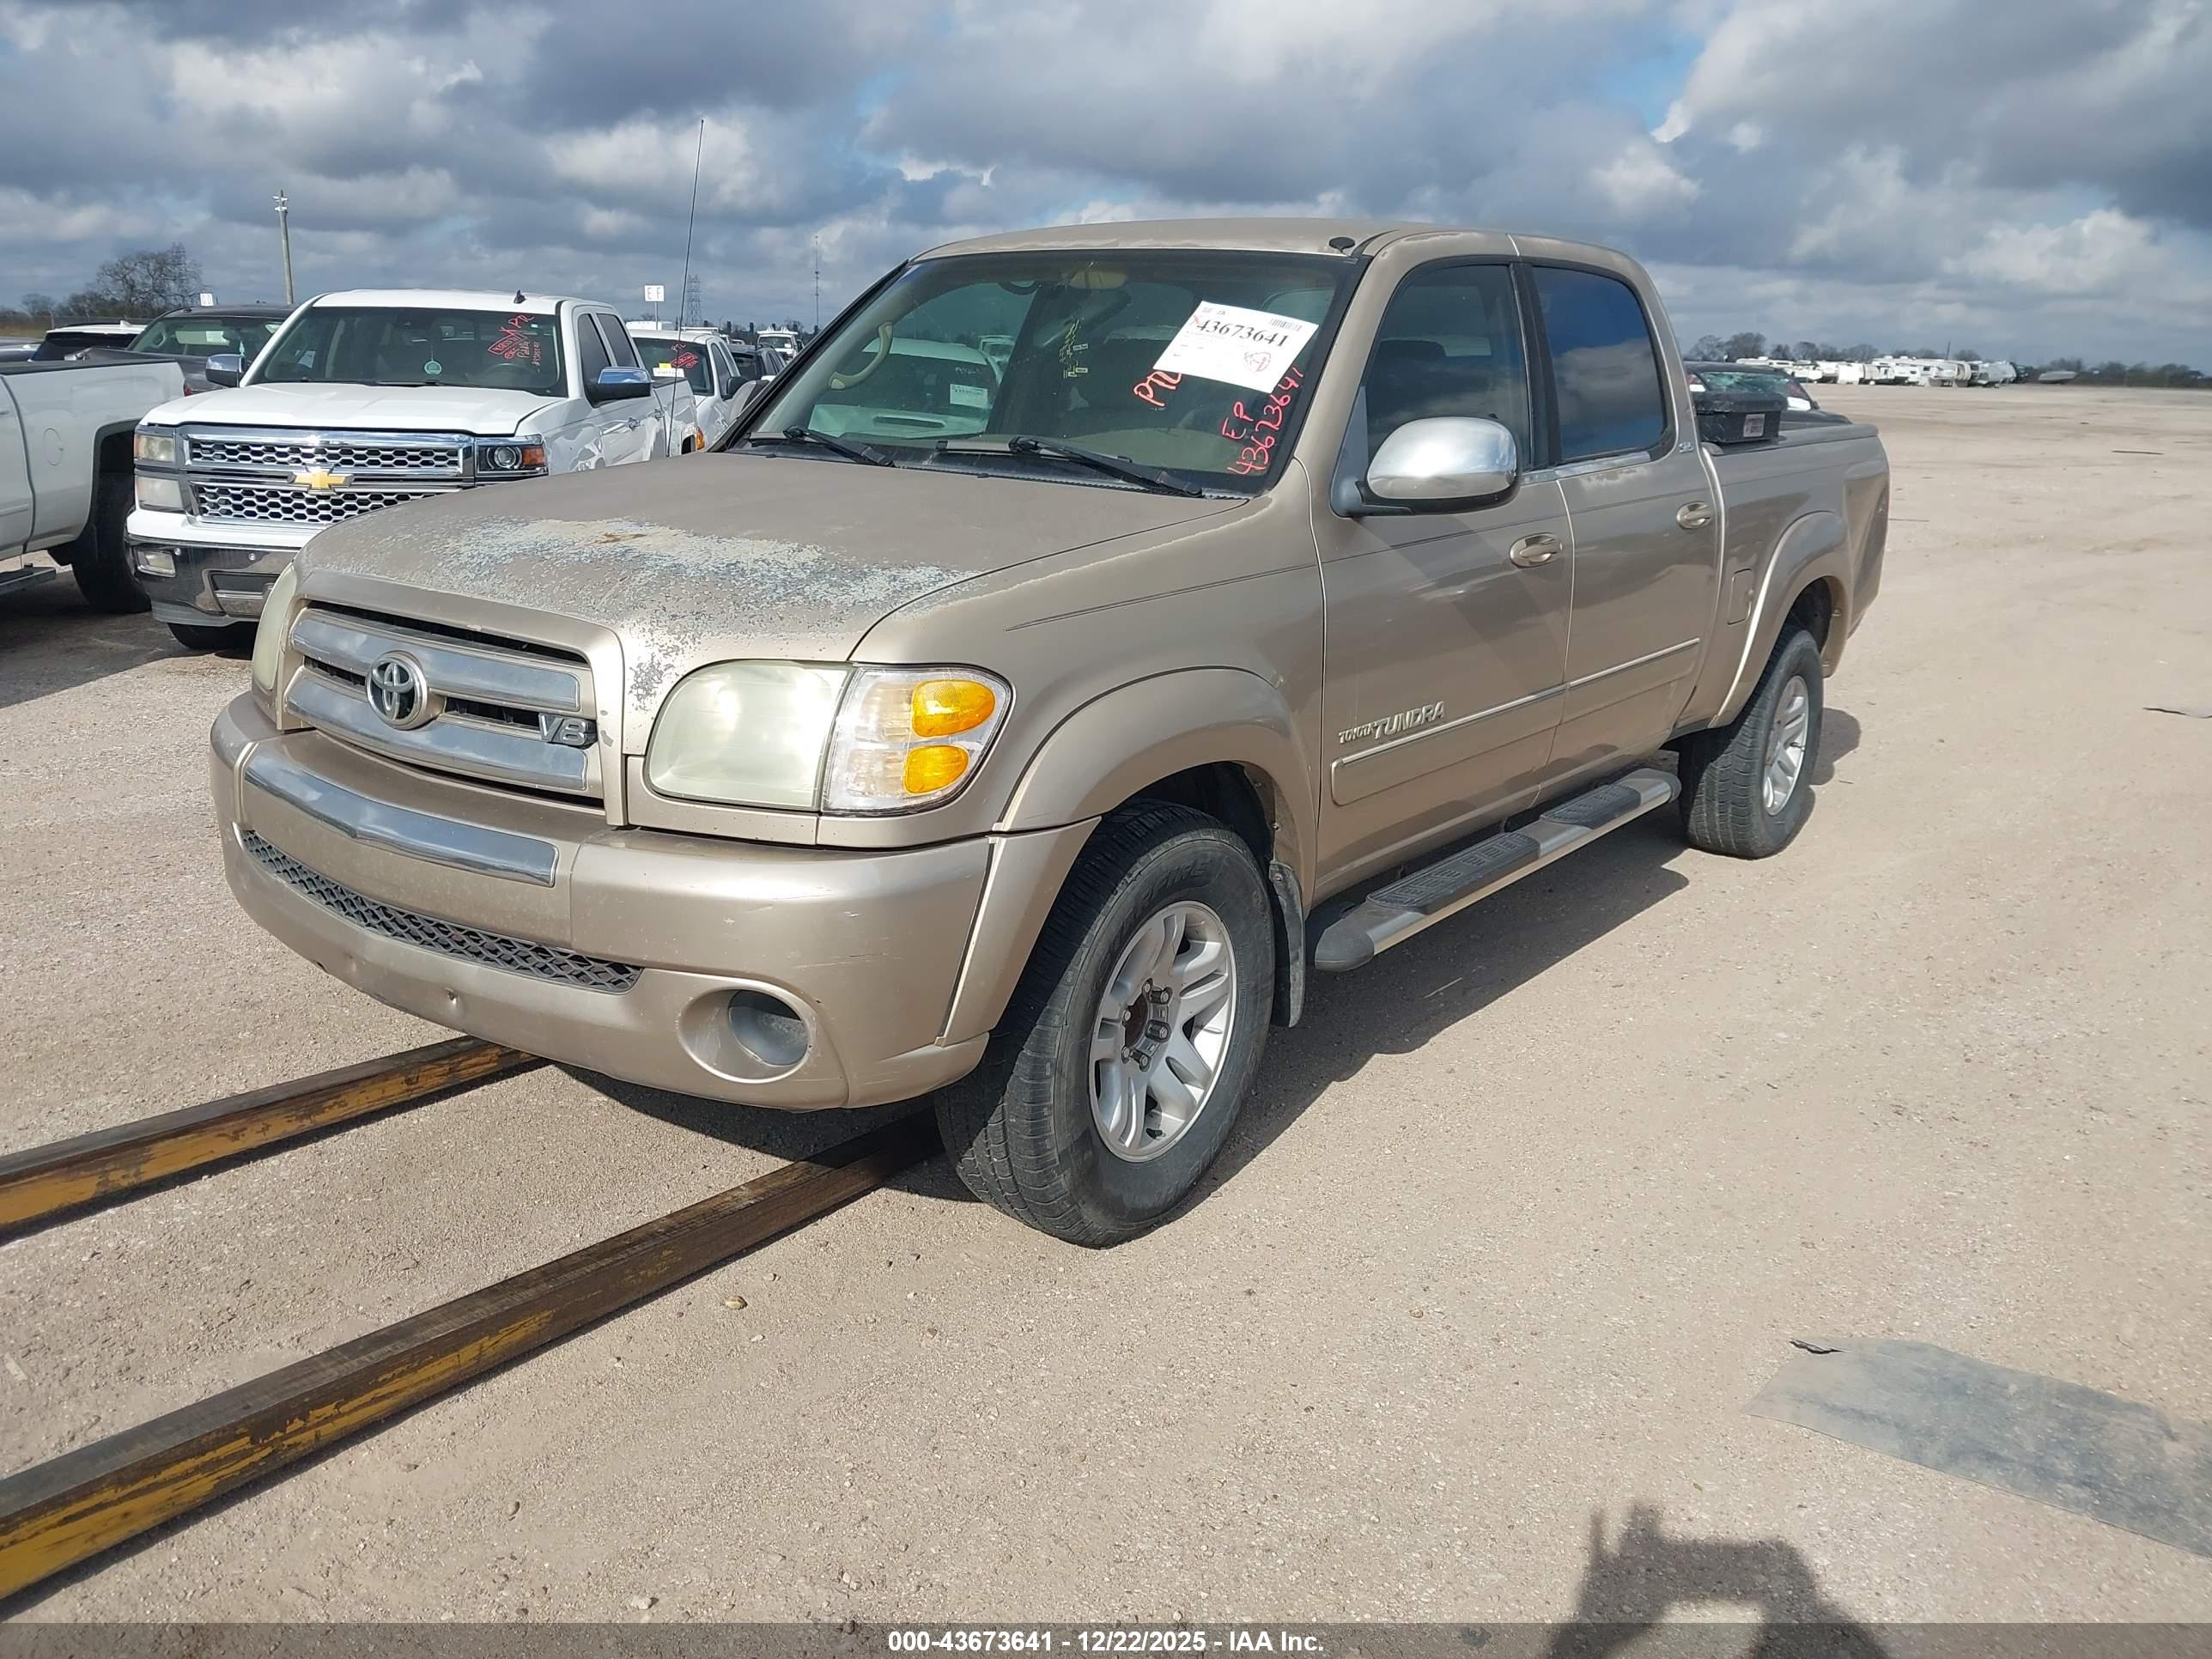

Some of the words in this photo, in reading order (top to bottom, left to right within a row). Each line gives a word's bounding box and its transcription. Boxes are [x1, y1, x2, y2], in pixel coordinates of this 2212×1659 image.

[1196, 319, 1289, 347] 43673641
[538, 713, 587, 747] V8
[1375, 700, 1444, 739] TUNDRA
